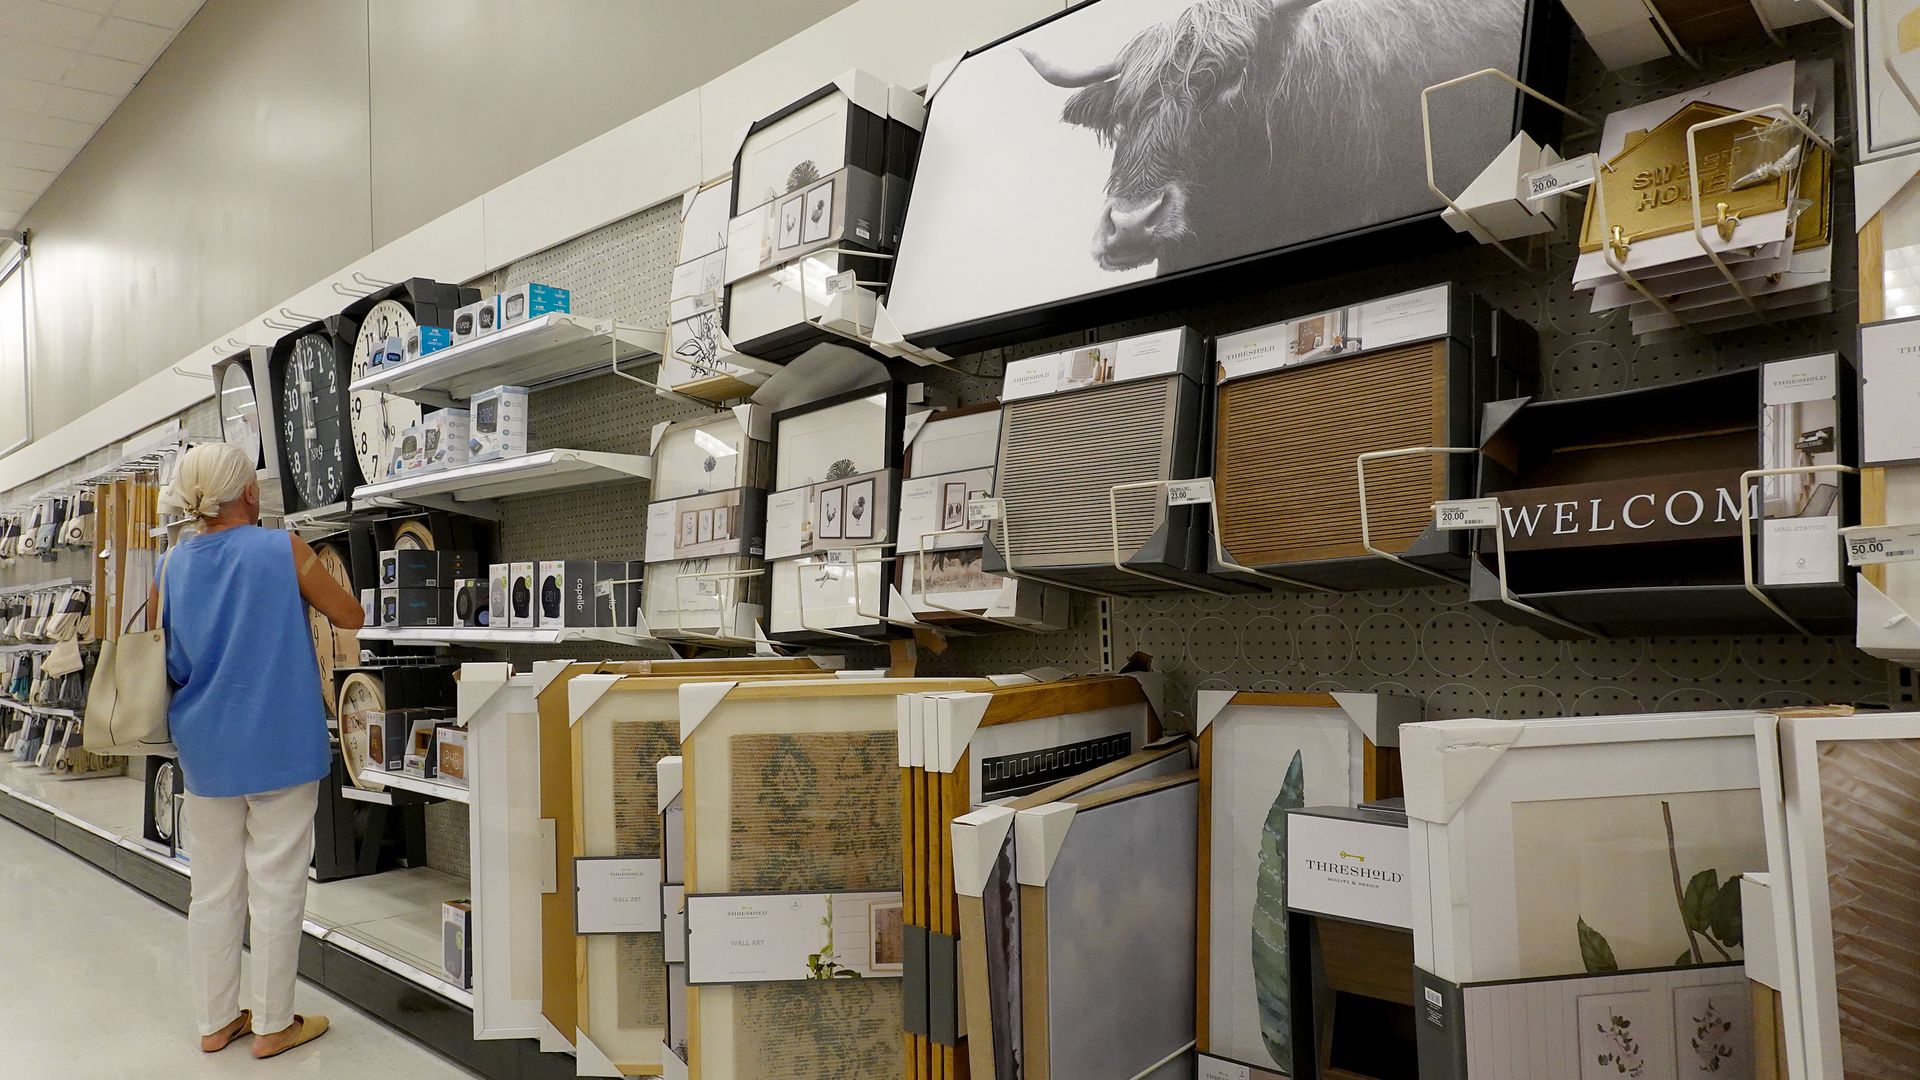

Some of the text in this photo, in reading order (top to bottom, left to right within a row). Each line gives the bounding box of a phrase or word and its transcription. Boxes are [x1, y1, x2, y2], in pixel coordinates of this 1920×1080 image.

[1533, 178, 1558, 192] 20.00
[377, 315, 389, 341] 12
[303, 346, 314, 372] 12
[317, 350, 324, 374] 1
[328, 370, 336, 394] 2
[288, 388, 299, 412] 10
[354, 396, 362, 420] 9
[287, 420, 294, 442] 9
[333, 438, 342, 461] 4
[361, 431, 368, 455] 8
[294, 451, 301, 474] 8
[372, 454, 378, 478] 7
[304, 471, 312, 494] 7
[327, 466, 335, 489] 5
[317, 478, 324, 501] 6
[1170, 491, 1187, 500] 23.00
[1442, 511, 1465, 521] 20.00
[1851, 542, 1884, 555] 50.00
[575, 578, 585, 611] capello
[1305, 859, 1403, 883] THRESHOLD
